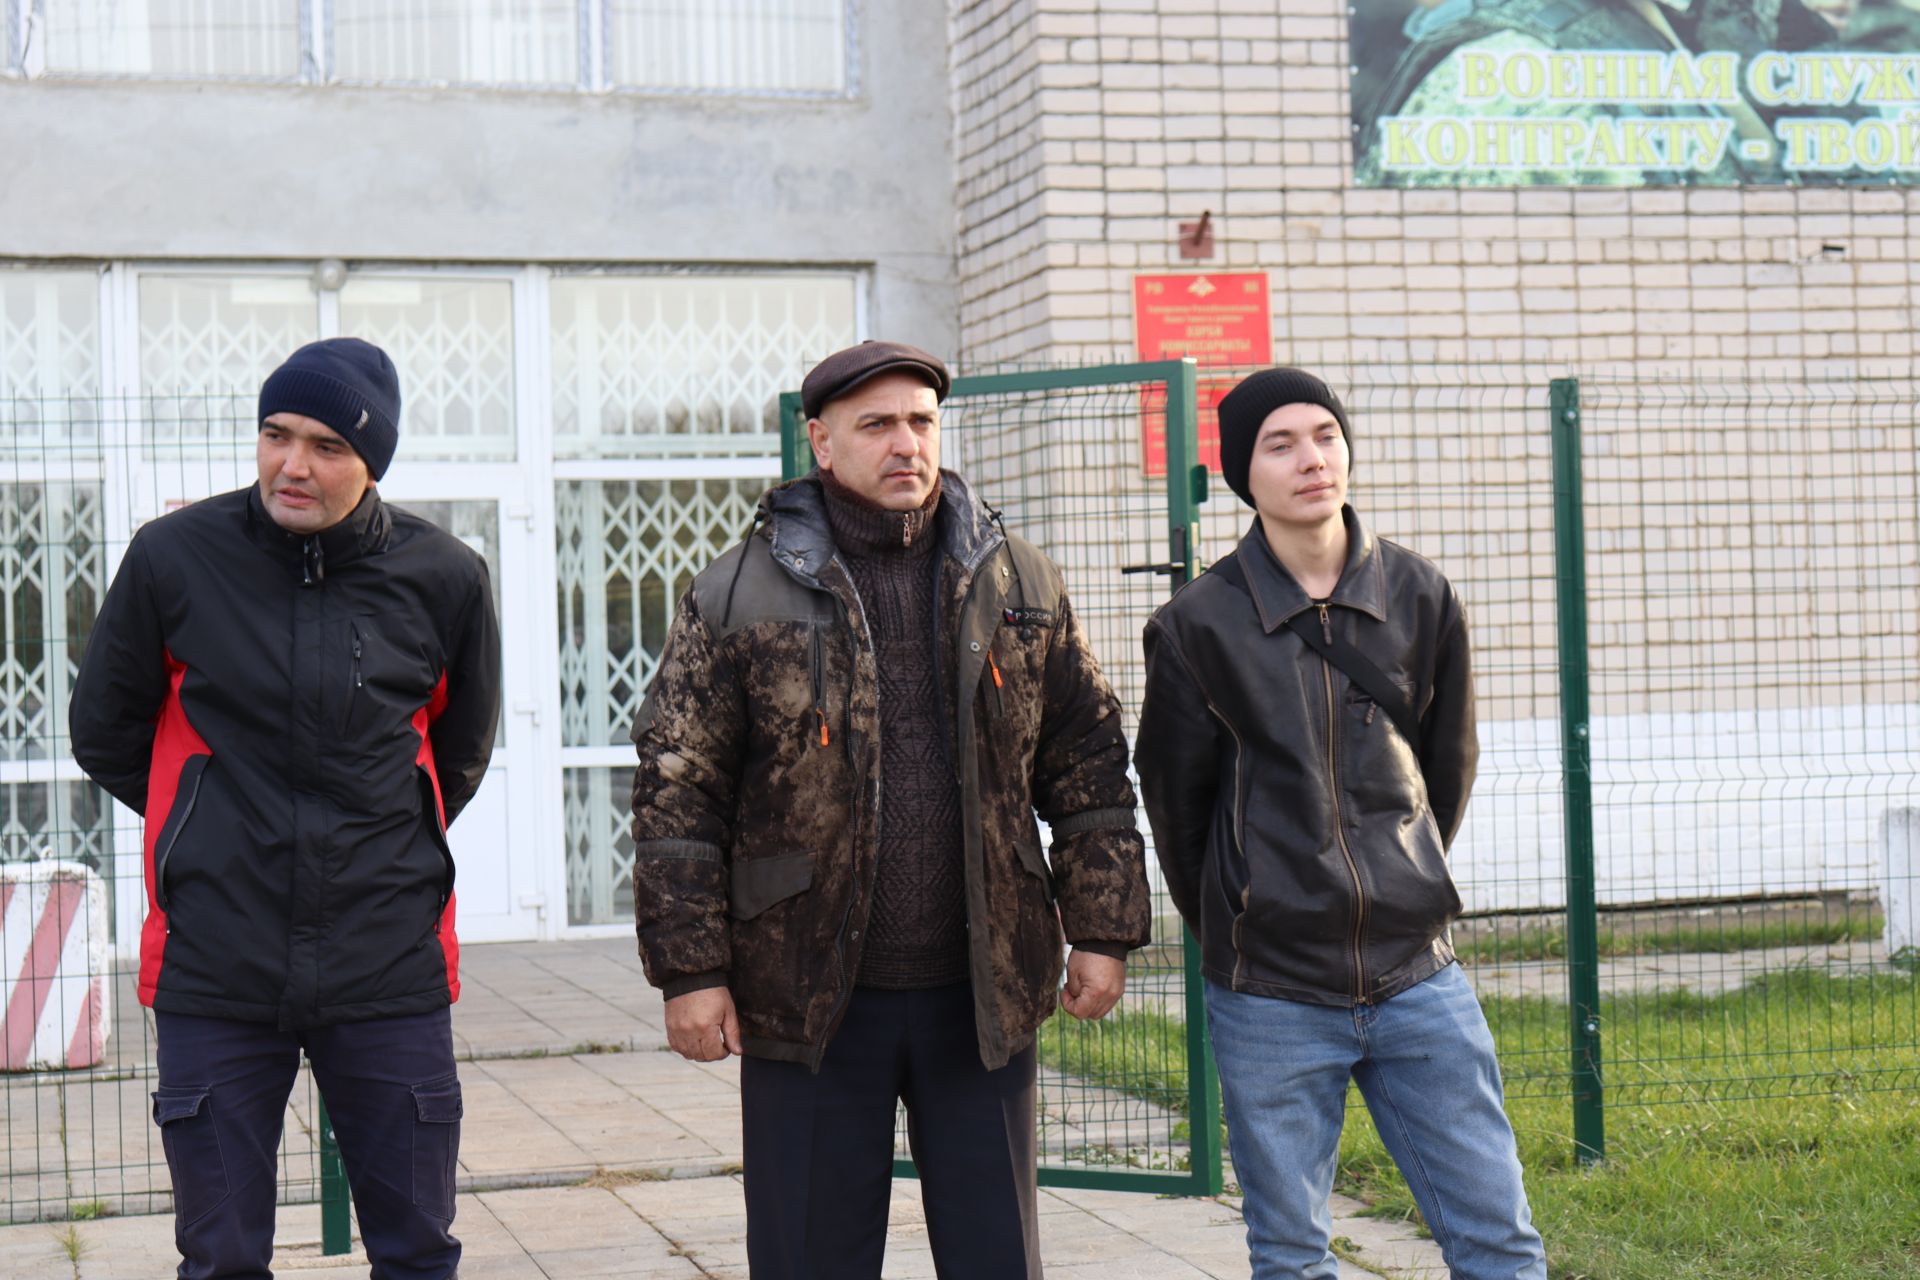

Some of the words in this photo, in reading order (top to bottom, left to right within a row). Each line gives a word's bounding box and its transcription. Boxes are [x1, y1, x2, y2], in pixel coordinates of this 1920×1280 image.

[1461, 53, 1737, 100] ВОЕННАЯ
[1752, 53, 1920, 101] СЛУЖ
[1385, 119, 1732, 167] КОНТРАКТУ
